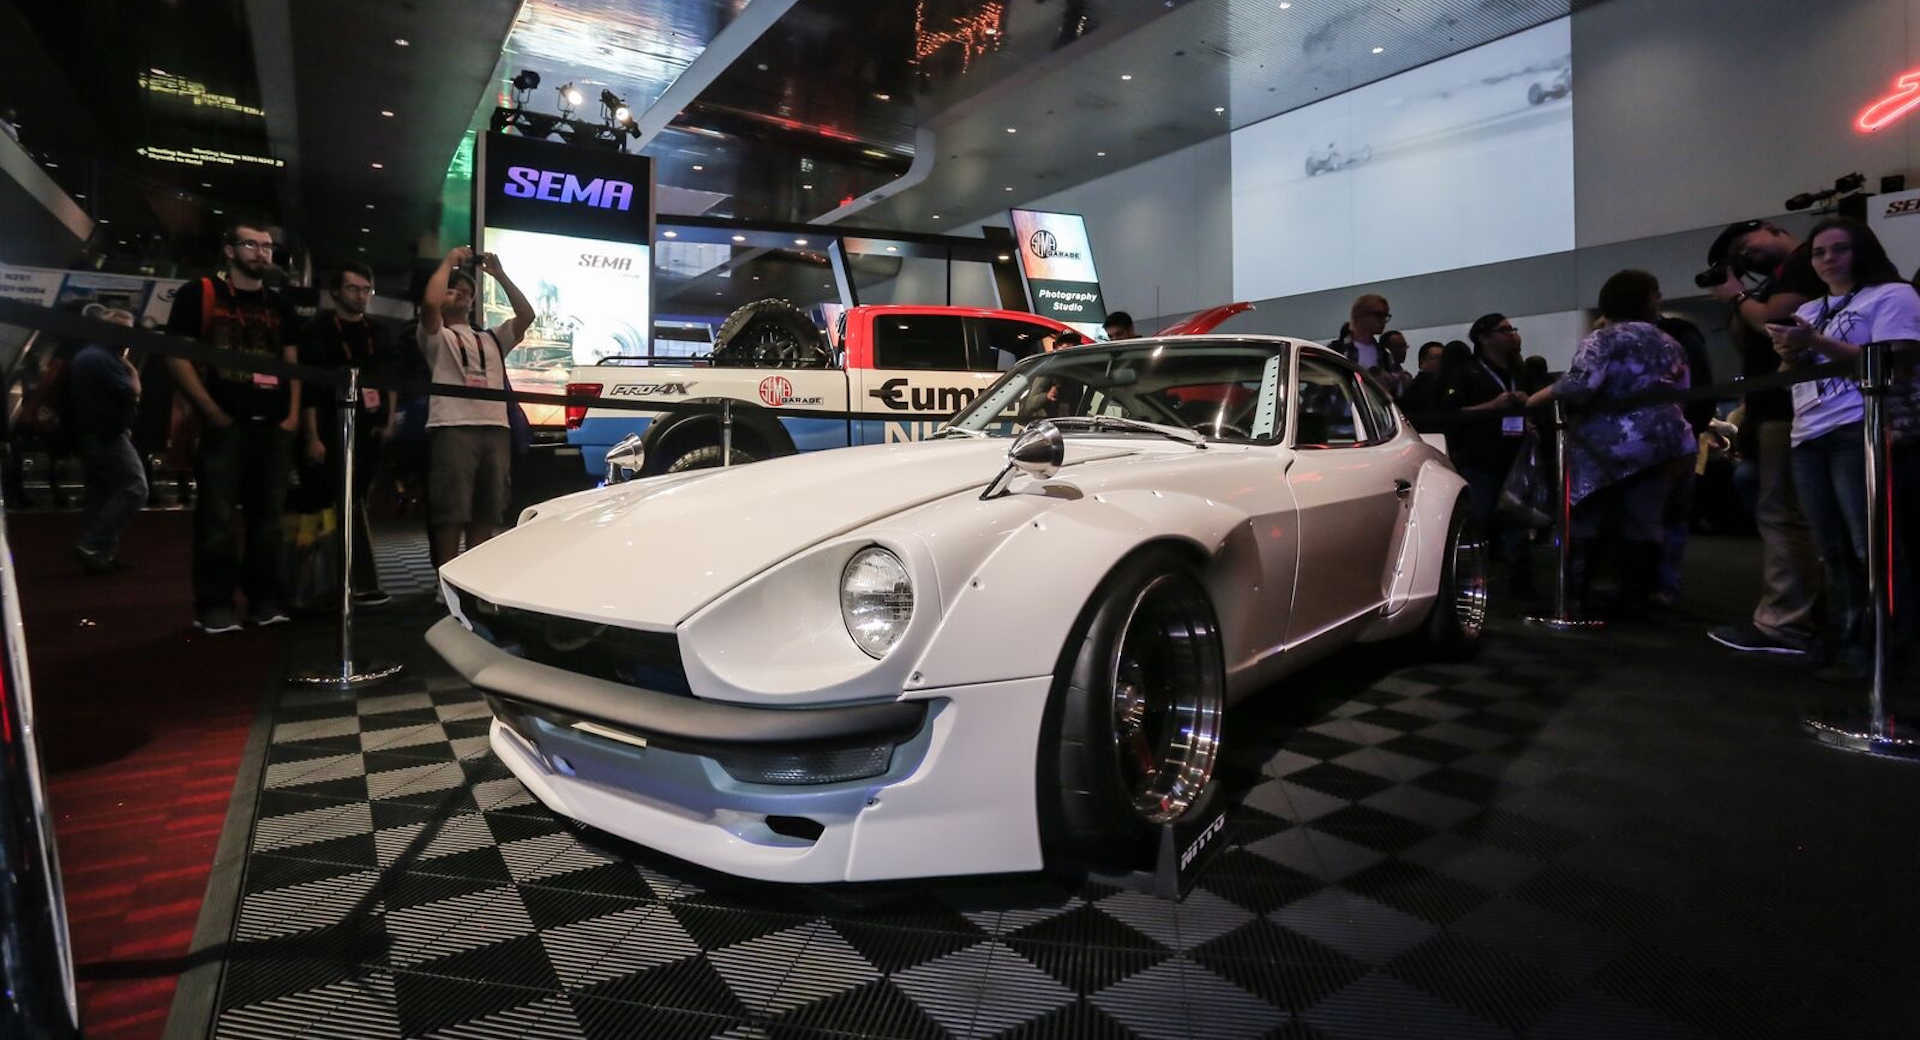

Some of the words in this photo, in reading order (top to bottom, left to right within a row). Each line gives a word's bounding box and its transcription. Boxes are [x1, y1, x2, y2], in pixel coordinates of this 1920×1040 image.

[504, 166, 634, 211] SEMA
[1886, 199, 1920, 214] SE
[578, 253, 632, 271] SEMA
[1046, 250, 1081, 260] GARAGE
[1039, 289, 1098, 303] Photography
[1053, 301, 1083, 312] Studio
[781, 397, 822, 405] GARAGE
[1181, 813, 1225, 872] NITTO
